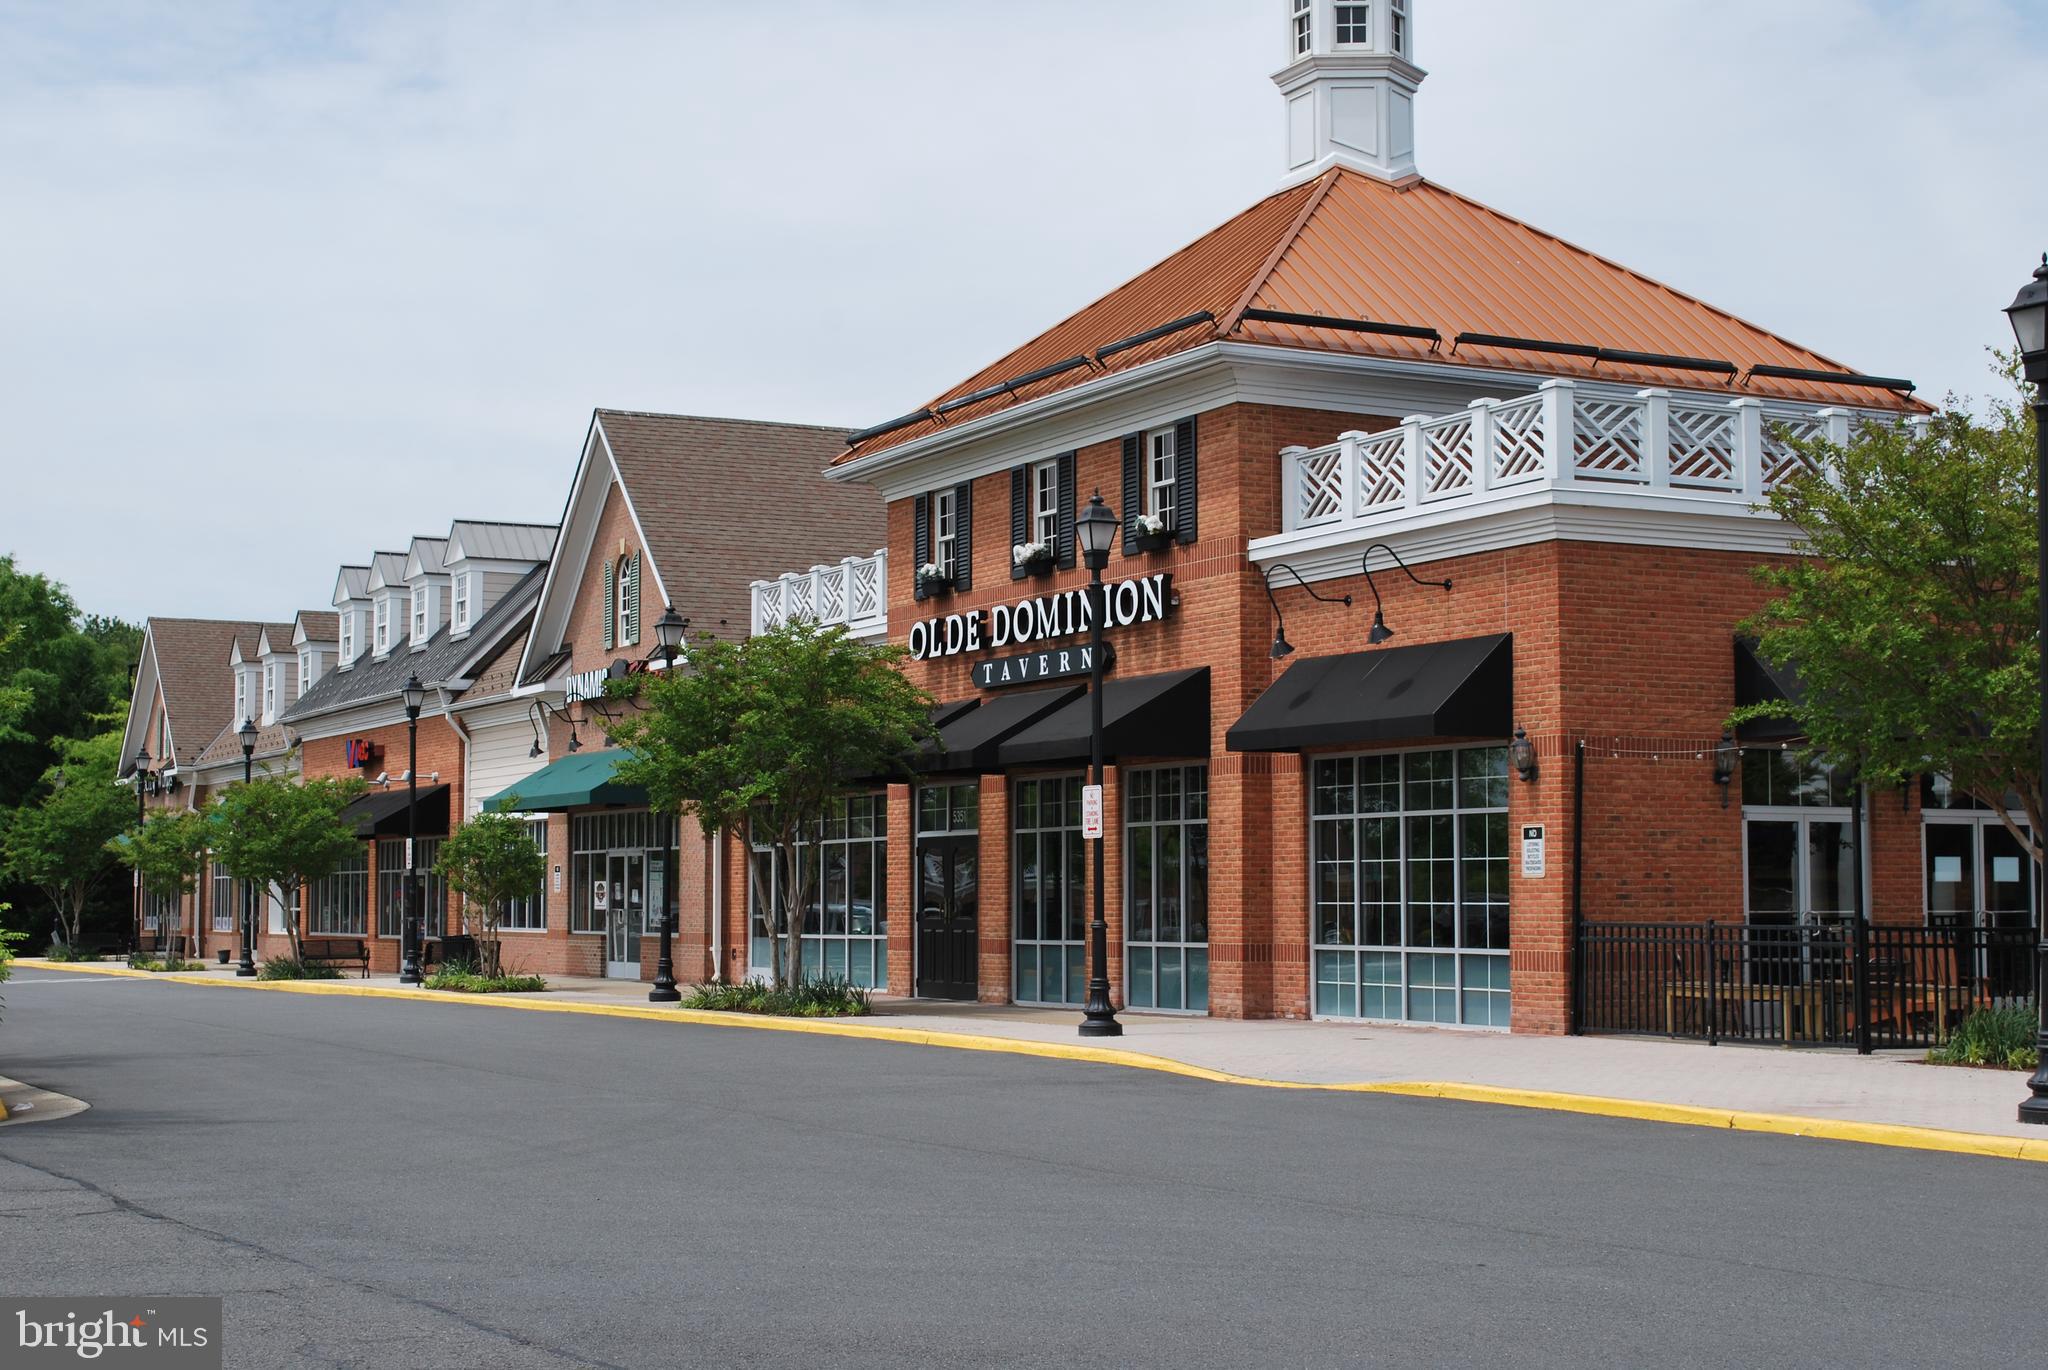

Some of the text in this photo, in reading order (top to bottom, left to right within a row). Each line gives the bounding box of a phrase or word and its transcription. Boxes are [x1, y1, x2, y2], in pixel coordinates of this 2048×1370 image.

[908, 573, 1165, 661] OLDE DOMINION
[982, 647, 1093, 684] TAVERN
